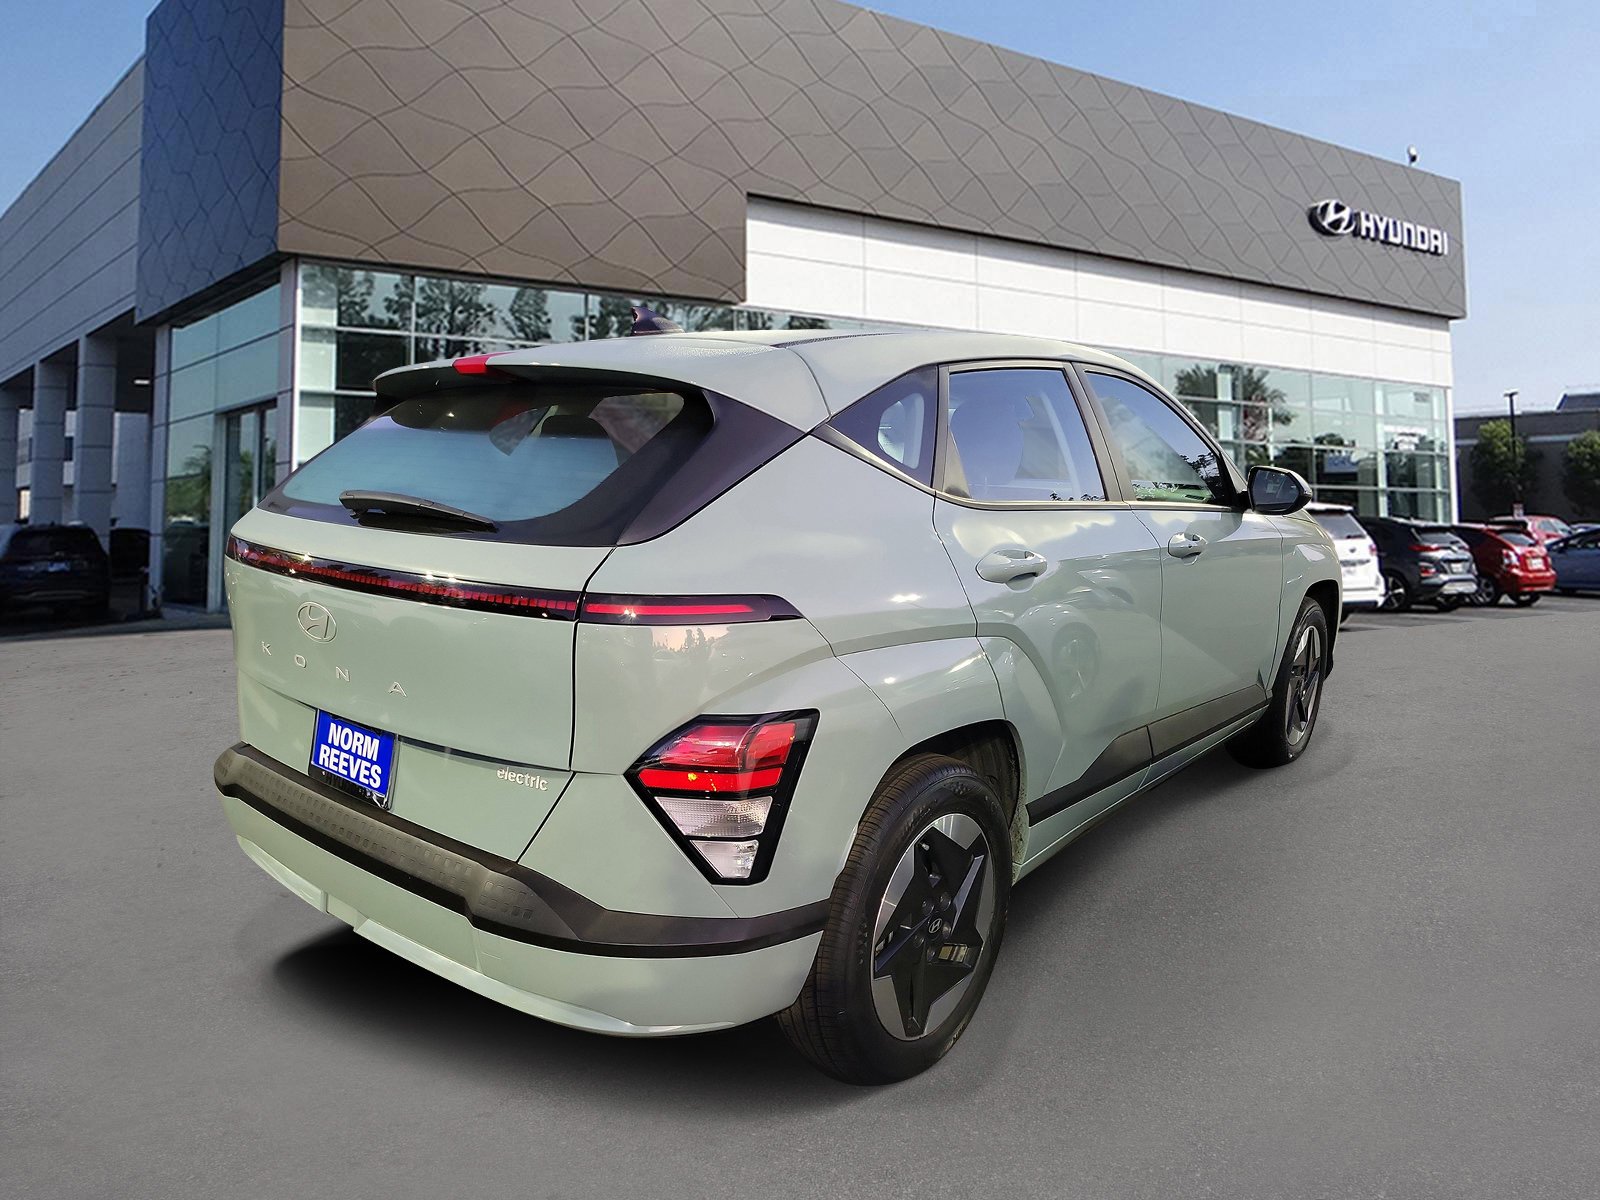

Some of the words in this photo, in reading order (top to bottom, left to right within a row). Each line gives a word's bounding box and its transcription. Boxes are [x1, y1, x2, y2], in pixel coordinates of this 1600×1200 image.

[1360, 211, 1449, 255] HYUNDAI
[327, 722, 380, 762] NORM
[318, 743, 382, 789] REEVES
[496, 766, 549, 791] electric
